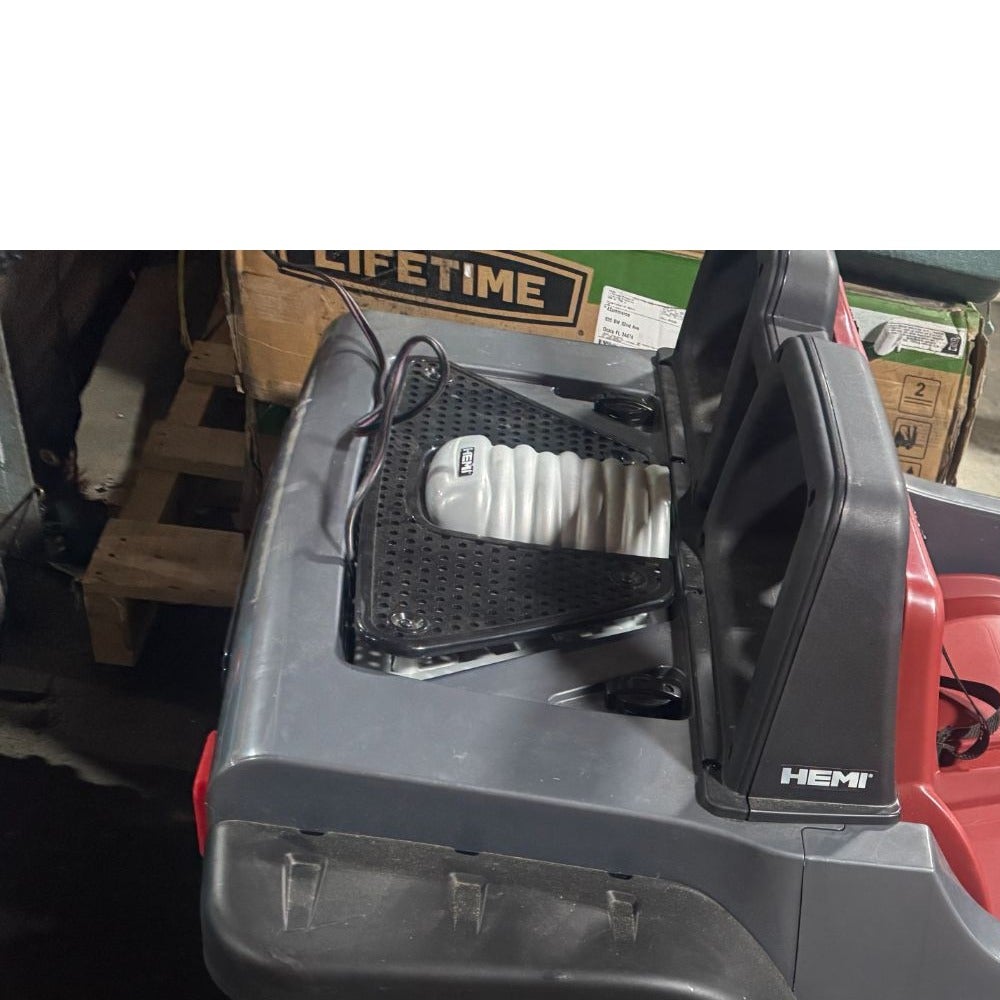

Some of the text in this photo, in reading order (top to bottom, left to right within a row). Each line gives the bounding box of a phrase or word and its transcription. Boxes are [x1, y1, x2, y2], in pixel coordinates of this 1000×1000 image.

[314, 250, 546, 308] LIFETIME
[914, 382, 926, 397] 2
[461, 447, 473, 474] HEMI
[780, 767, 869, 789] HEMI
